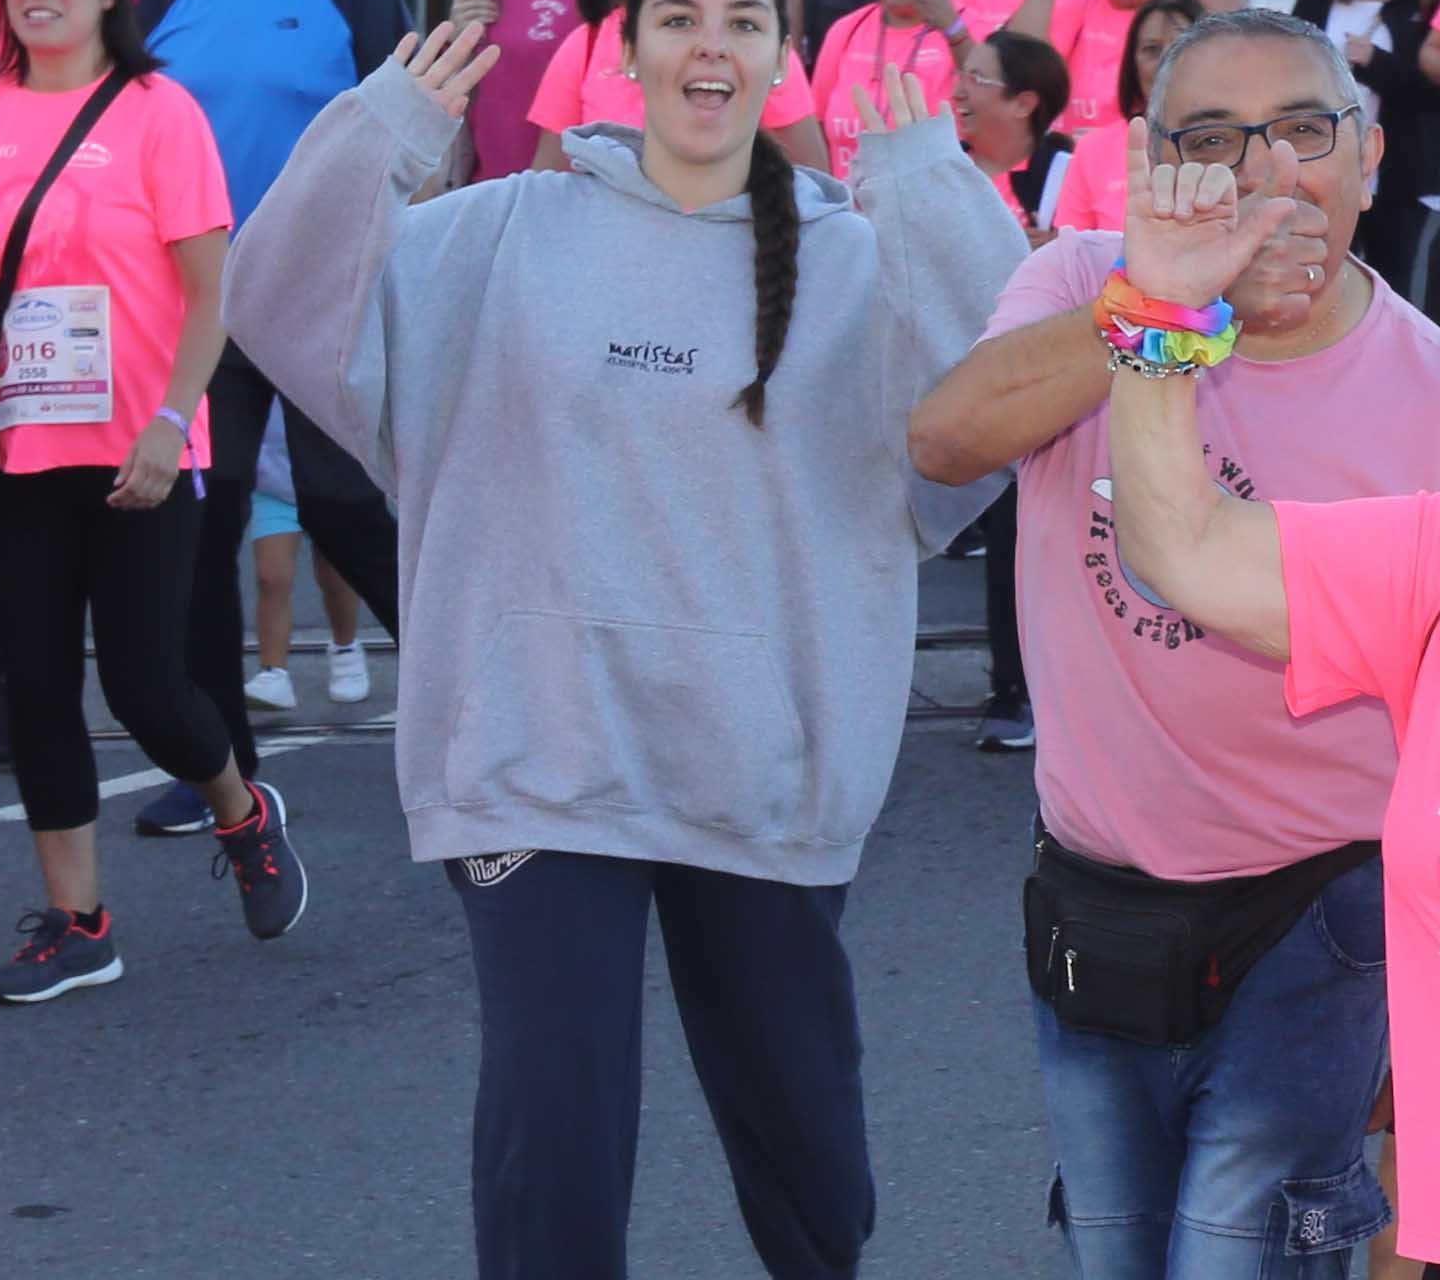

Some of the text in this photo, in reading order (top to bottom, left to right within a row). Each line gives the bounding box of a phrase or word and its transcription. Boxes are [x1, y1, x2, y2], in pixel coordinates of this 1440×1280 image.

[12, 341, 57, 362] 016
[608, 341, 700, 365] maristas
[1133, 614, 1206, 650] righ
